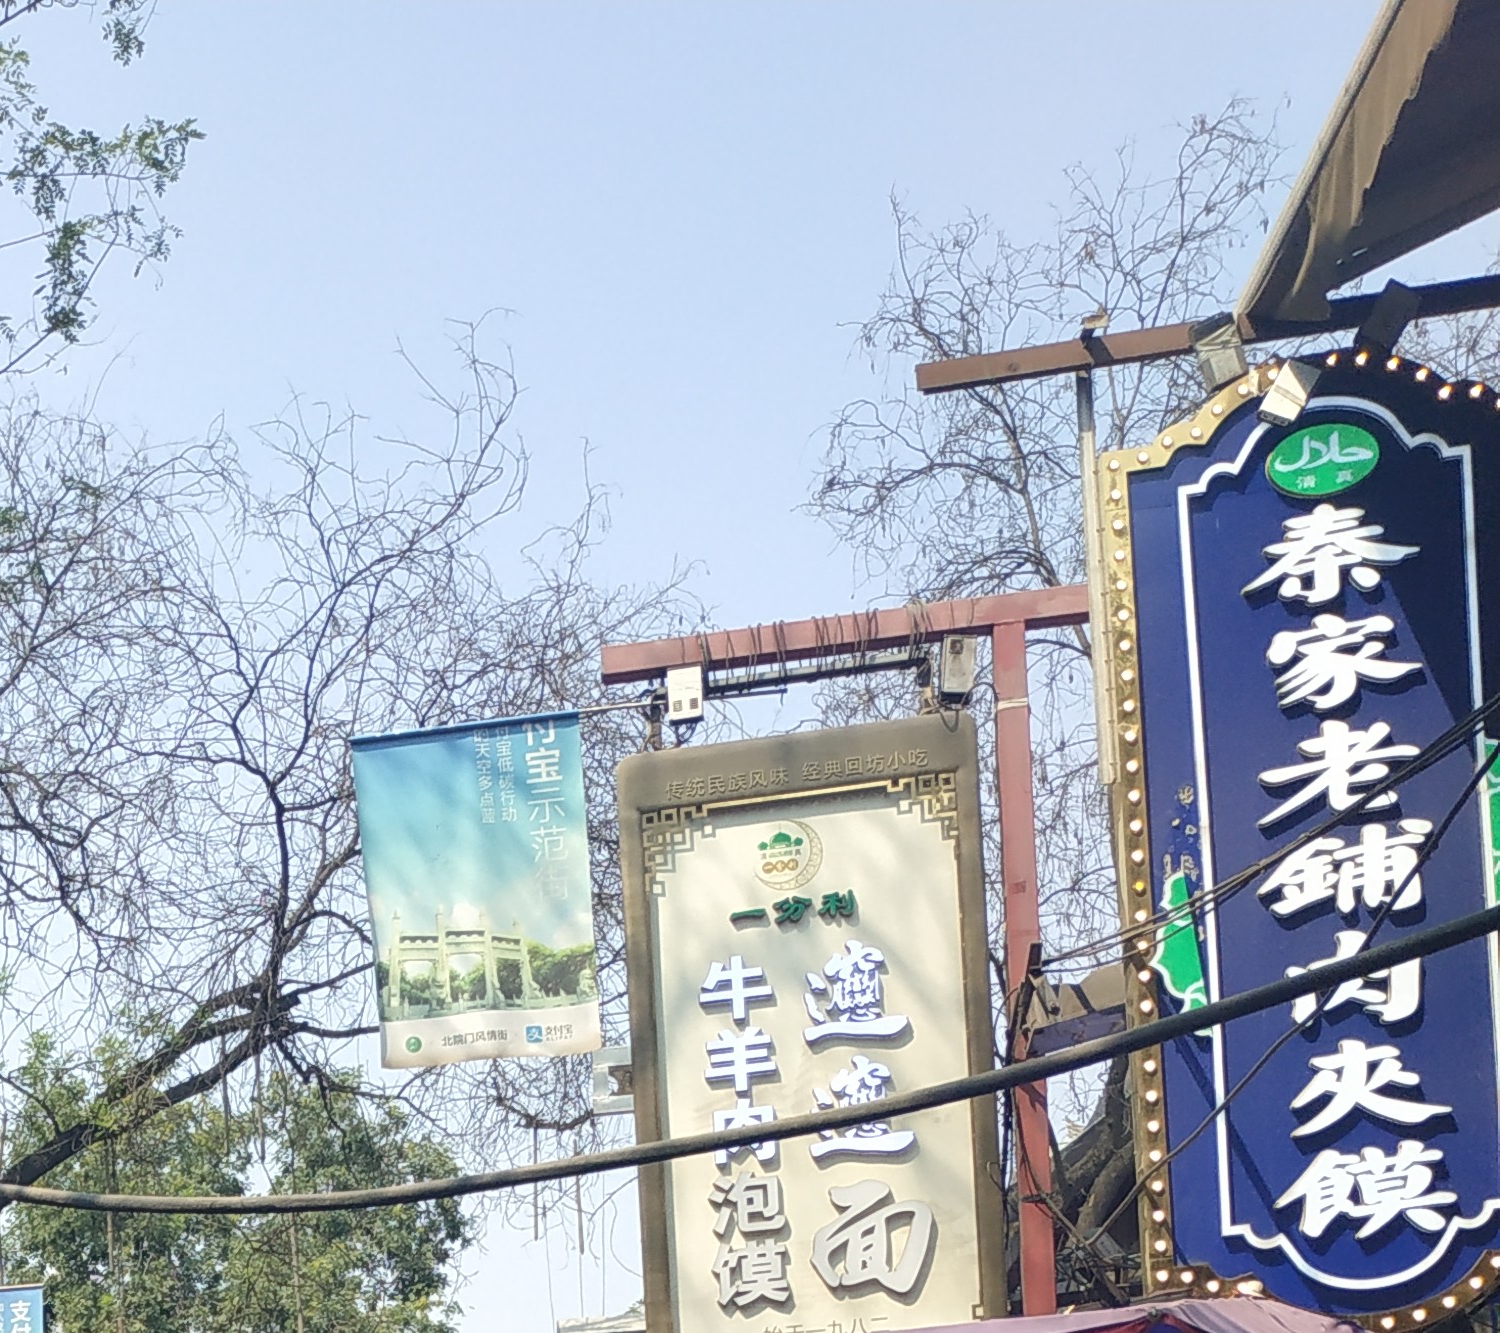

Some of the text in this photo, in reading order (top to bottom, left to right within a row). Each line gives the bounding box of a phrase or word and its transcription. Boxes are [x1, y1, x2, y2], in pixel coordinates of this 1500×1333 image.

[664, 747, 929, 801] 传统民族风味 经典回坊小吃
[729, 888, 857, 924] 一分利
[700, 954, 792, 1311] 牛羊肉泡馍
